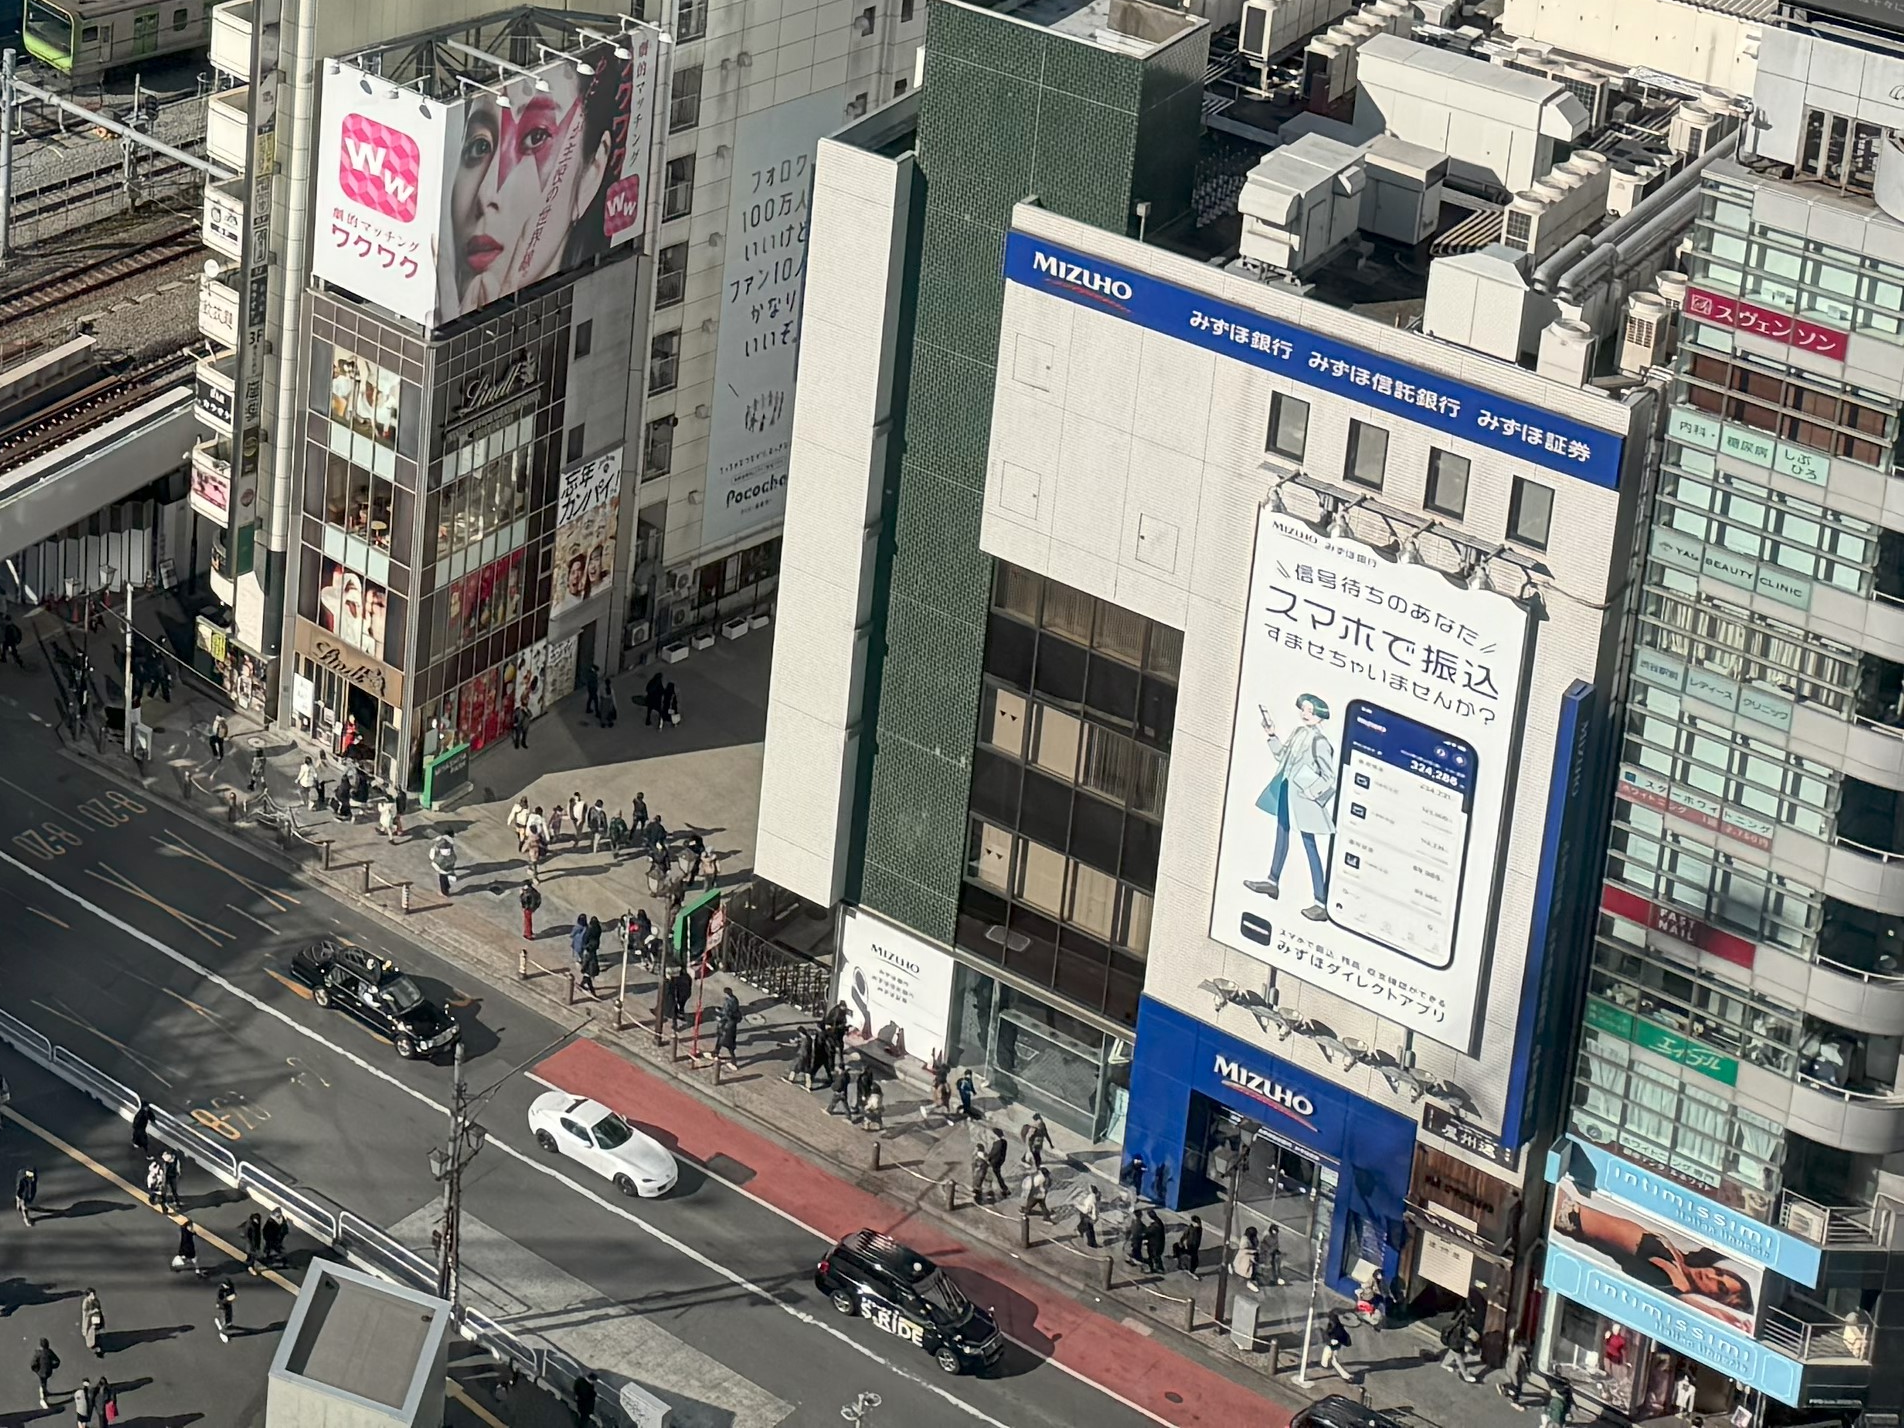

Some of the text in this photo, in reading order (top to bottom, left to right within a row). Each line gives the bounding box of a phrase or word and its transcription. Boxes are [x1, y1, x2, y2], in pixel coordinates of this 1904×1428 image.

[332, 224, 419, 279] ワクワク
[1034, 251, 1133, 302] MIZUHO
[249, 329, 263, 344] 3F
[1714, 301, 1837, 351] スヴェンソン
[1188, 310, 1592, 463] みずほ銀行 みずほ信託銀行 みずほ証券
[1271, 519, 1319, 545] MIZUHO
[1294, 562, 1479, 644] 信号待ちのあなた
[1704, 557, 1803, 598] BEAUTY CLINIC
[1265, 585, 1500, 700] スマホで振込
[1266, 624, 1497, 727] すませちゃいませんか?
[1688, 676, 1735, 701] レディース
[1742, 697, 1789, 721] クリニック
[870, 943, 920, 974] MIZUHO
[1277, 940, 1446, 1023] みずほダイレクトアプリ
[1213, 1054, 1314, 1116] MIZUHO
[1614, 1166, 1774, 1249] intimissimi
[1594, 1278, 1751, 1362] intimissimi
